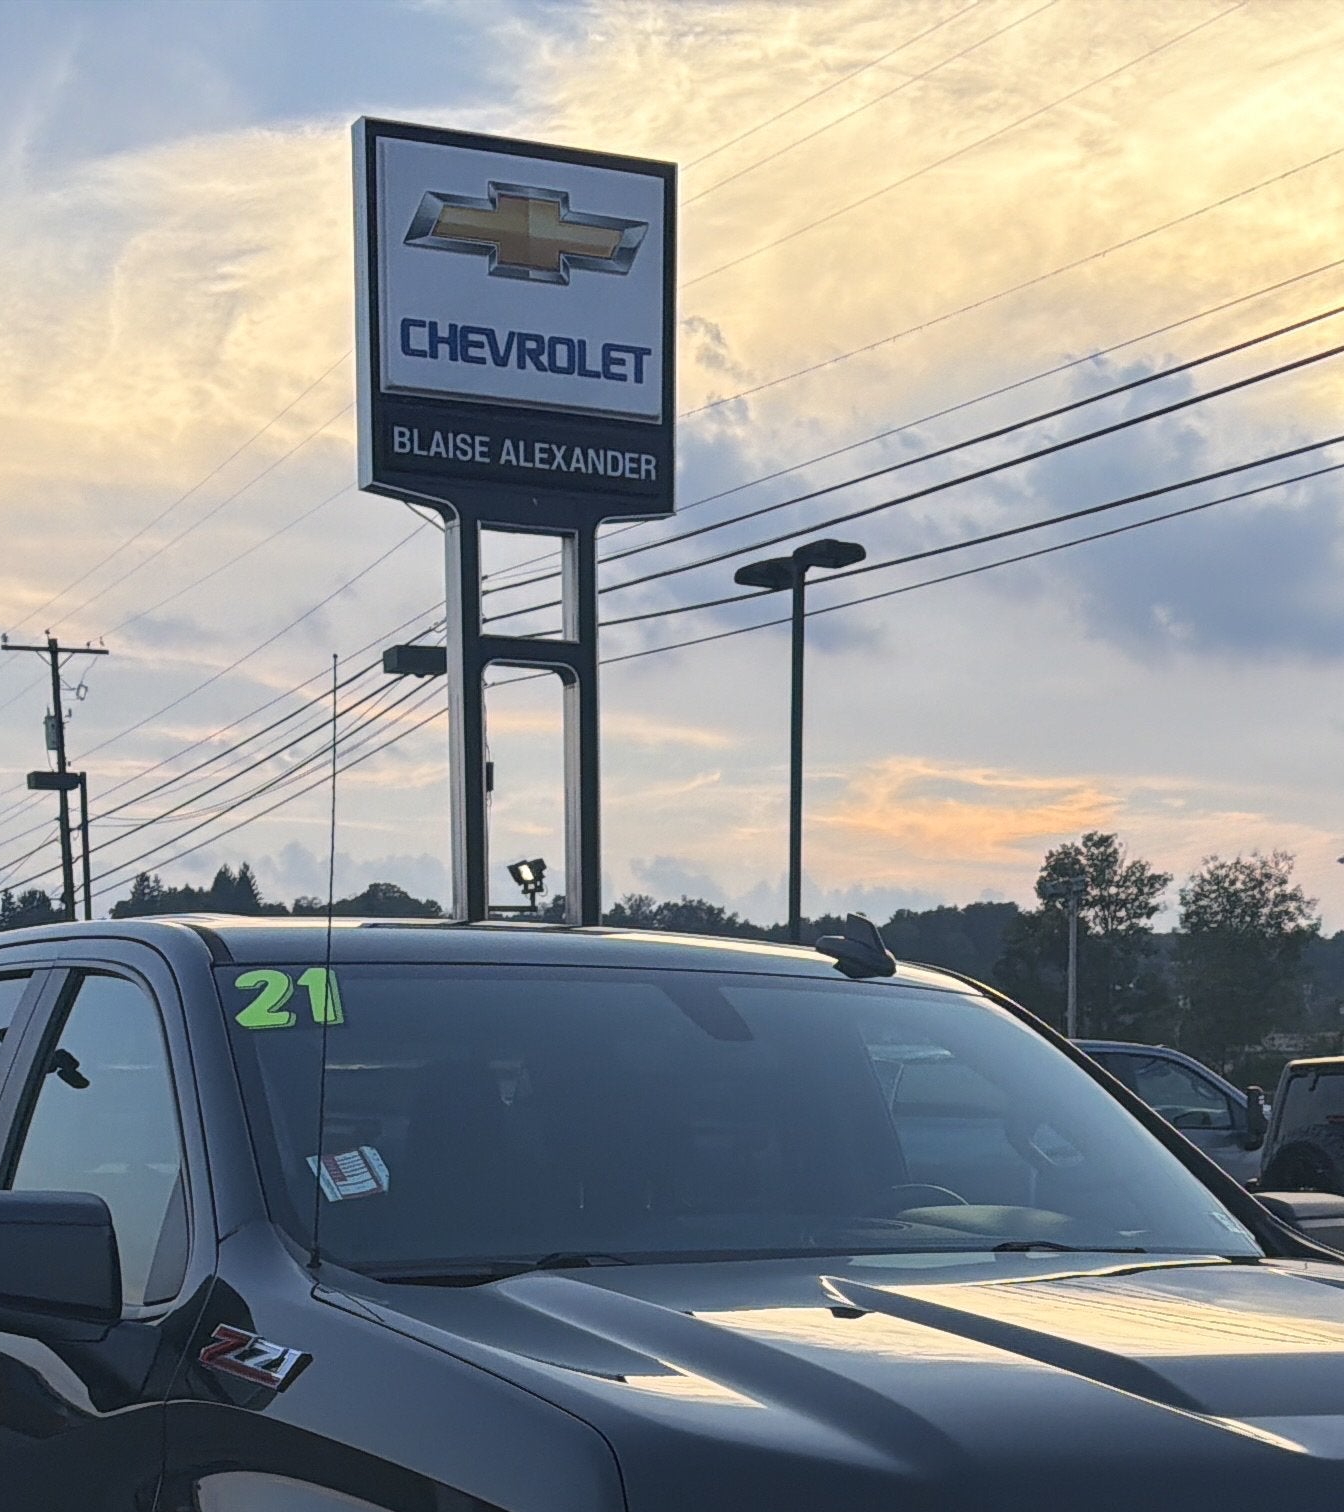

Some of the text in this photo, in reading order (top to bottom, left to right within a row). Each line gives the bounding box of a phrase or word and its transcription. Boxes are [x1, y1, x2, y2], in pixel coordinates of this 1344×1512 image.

[400, 317, 652, 384] CHEVROLET
[393, 425, 657, 481] BLAISE ALEXANDER
[234, 966, 345, 1029] 21
[198, 1322, 308, 1392] Z71
